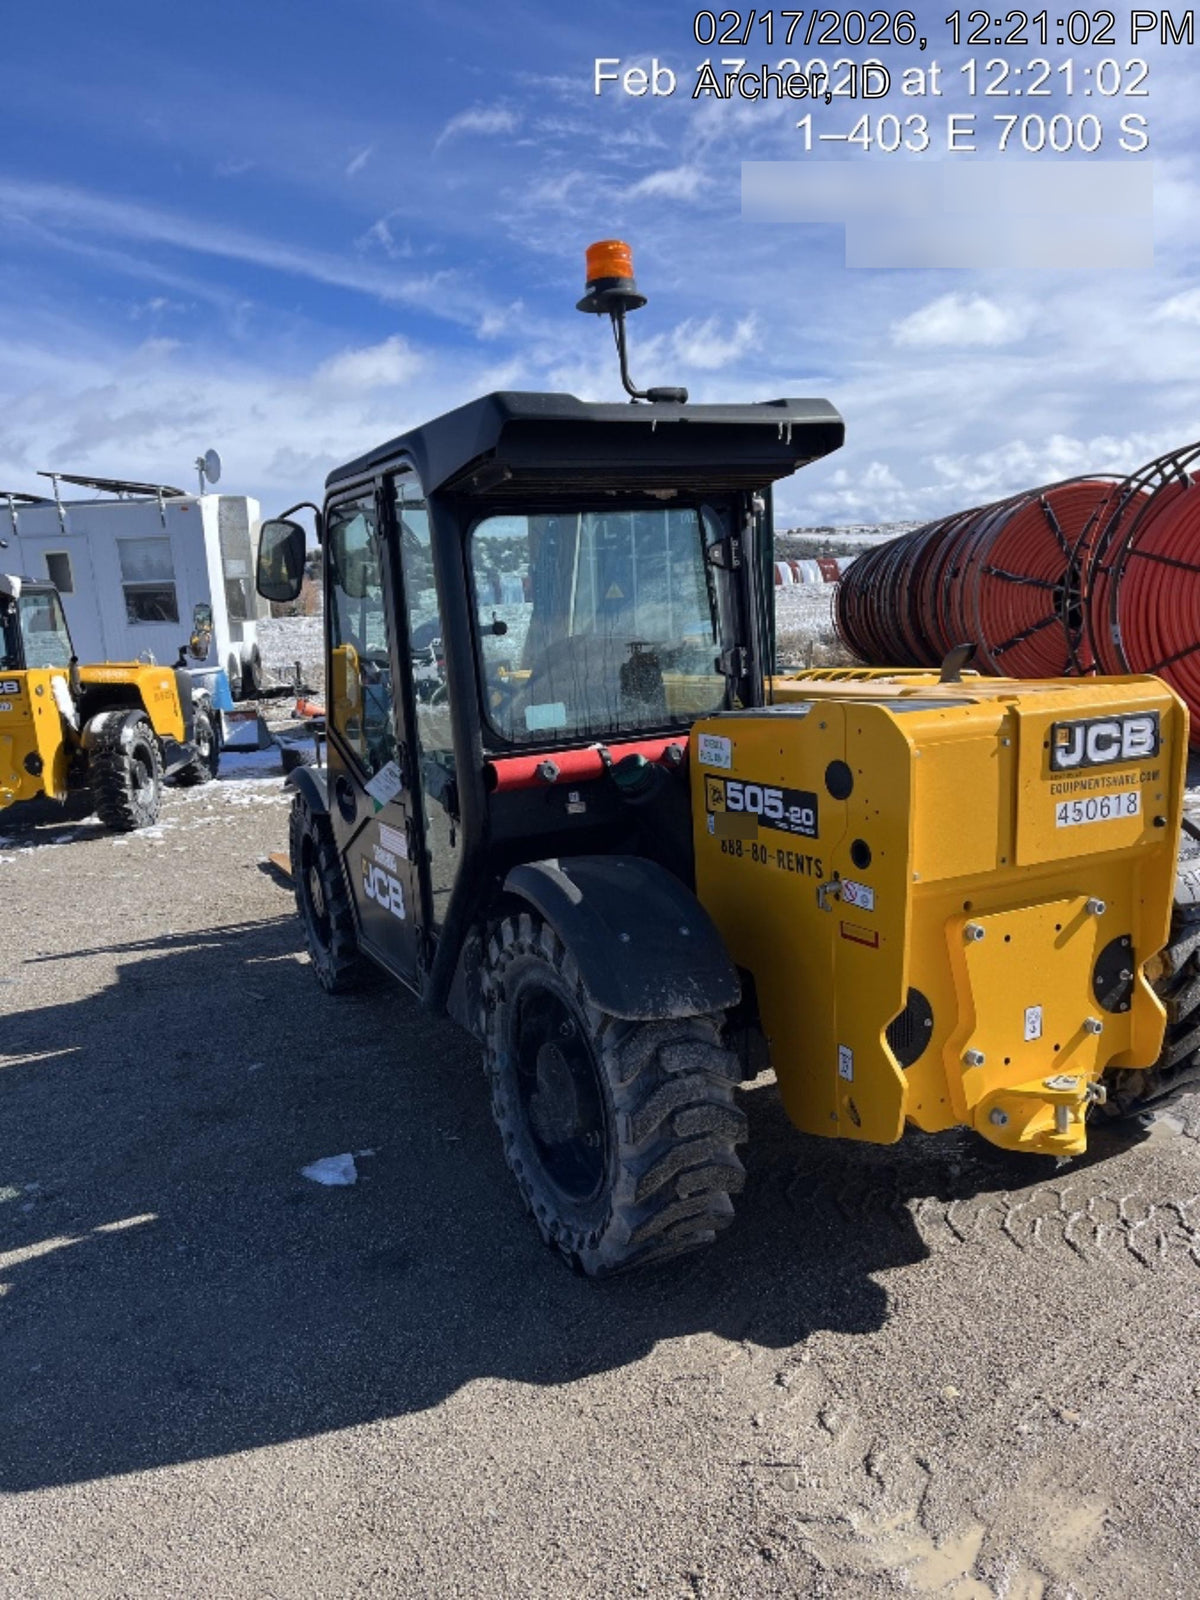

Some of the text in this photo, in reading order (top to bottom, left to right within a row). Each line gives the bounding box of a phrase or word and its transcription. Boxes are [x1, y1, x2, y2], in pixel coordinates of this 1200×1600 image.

[1054, 717, 1155, 768] JCB
[1057, 792, 1138, 824] 450618
[363, 862, 406, 921] JCB
